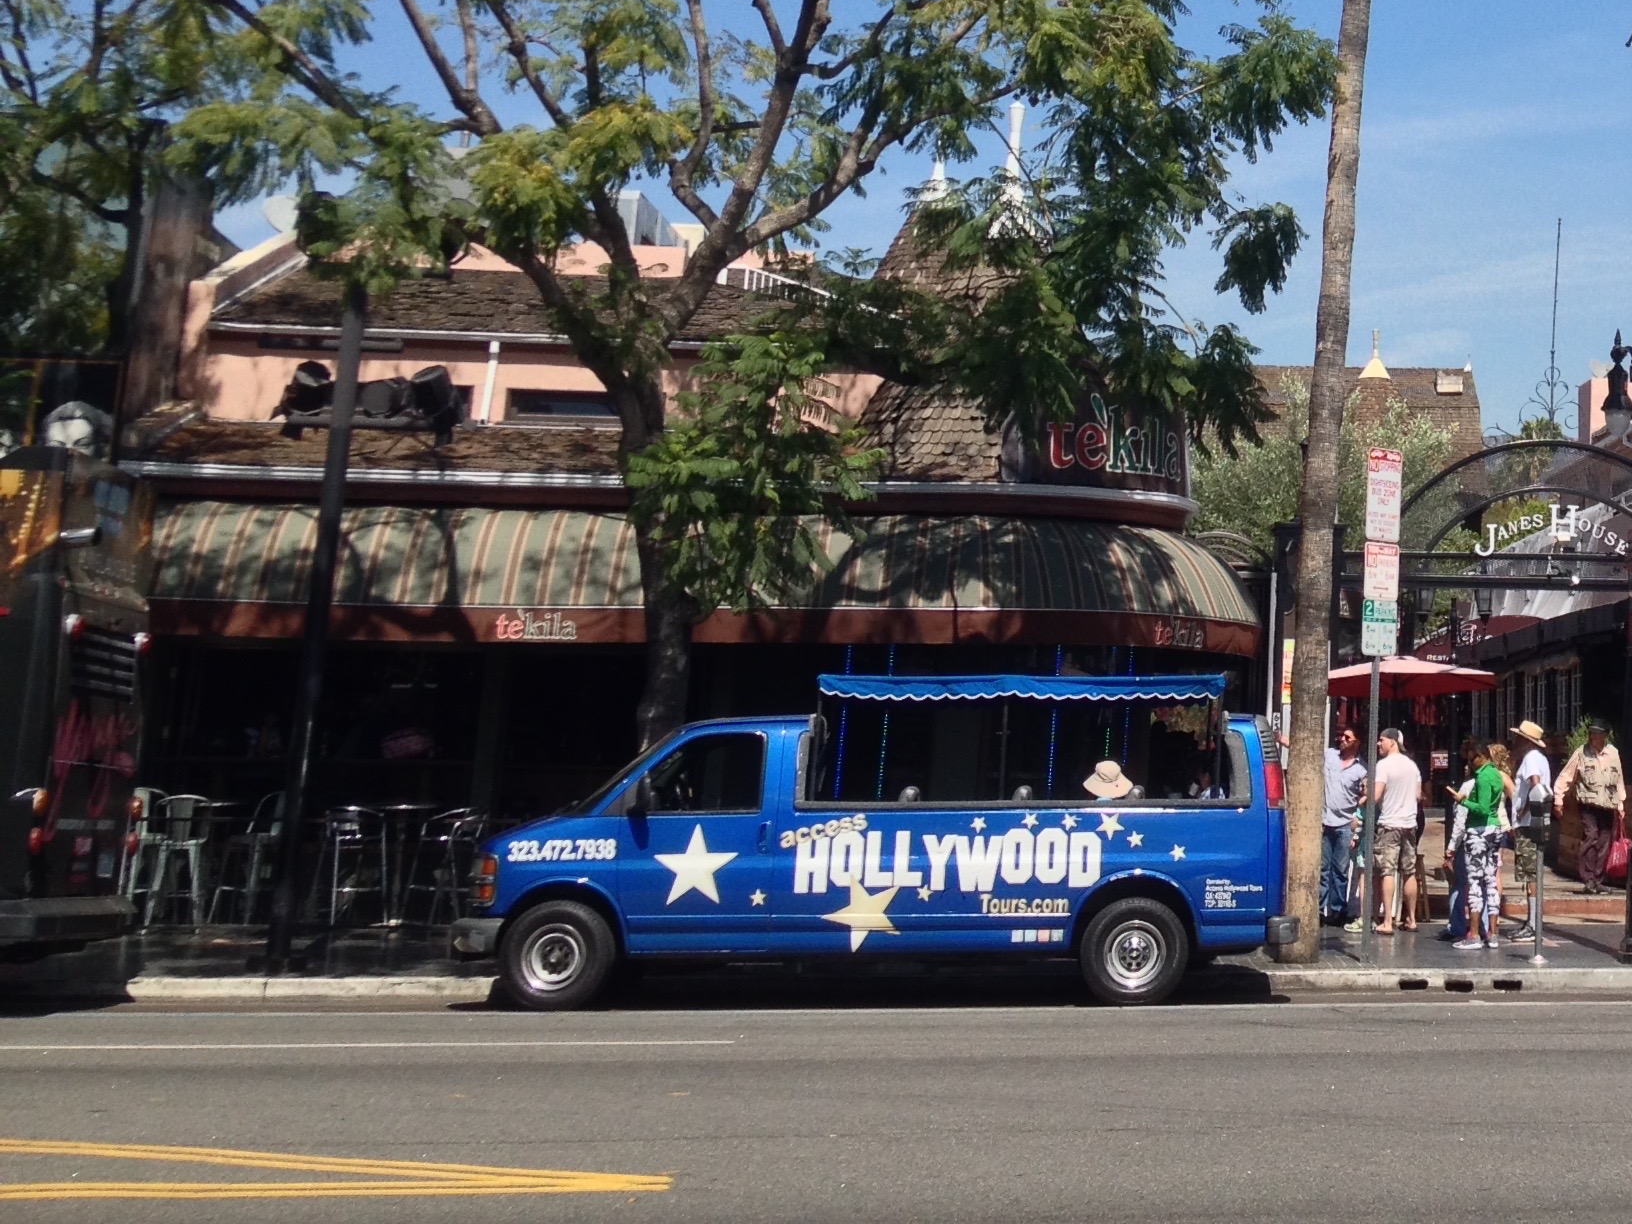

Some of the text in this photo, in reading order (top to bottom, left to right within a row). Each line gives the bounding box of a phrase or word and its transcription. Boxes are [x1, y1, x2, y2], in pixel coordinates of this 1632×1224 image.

[1365, 601, 1373, 616] 2
[780, 812, 869, 849] access
[507, 838, 618, 862] 323.472.7938
[793, 827, 1102, 894] HOLLYWOOD
[980, 894, 1070, 915] Tours.com
